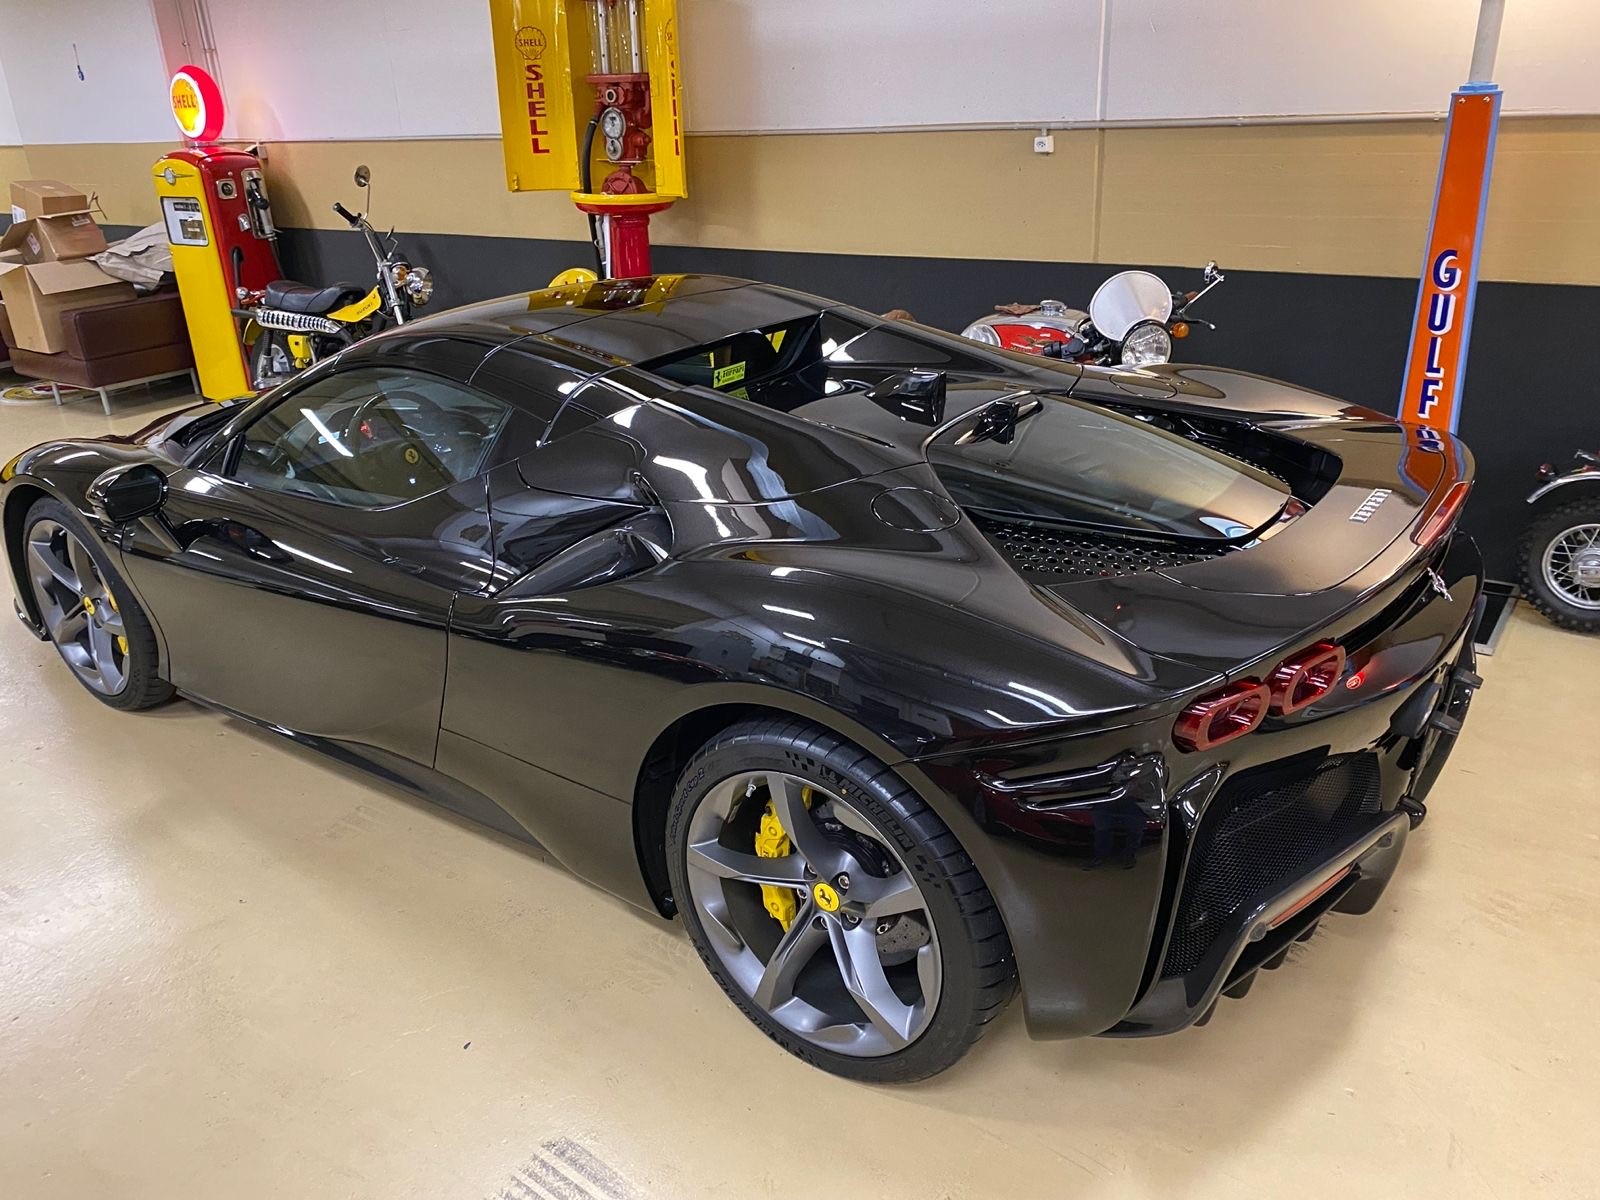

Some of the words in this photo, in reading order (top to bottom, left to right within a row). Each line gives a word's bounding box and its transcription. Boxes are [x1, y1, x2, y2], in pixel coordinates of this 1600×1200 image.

[519, 38, 543, 48] SHELL
[172, 94, 198, 110] SHELL
[525, 64, 550, 154] SHELL
[1417, 249, 1462, 419] GULF
[837, 777, 916, 853] MICHELIN
